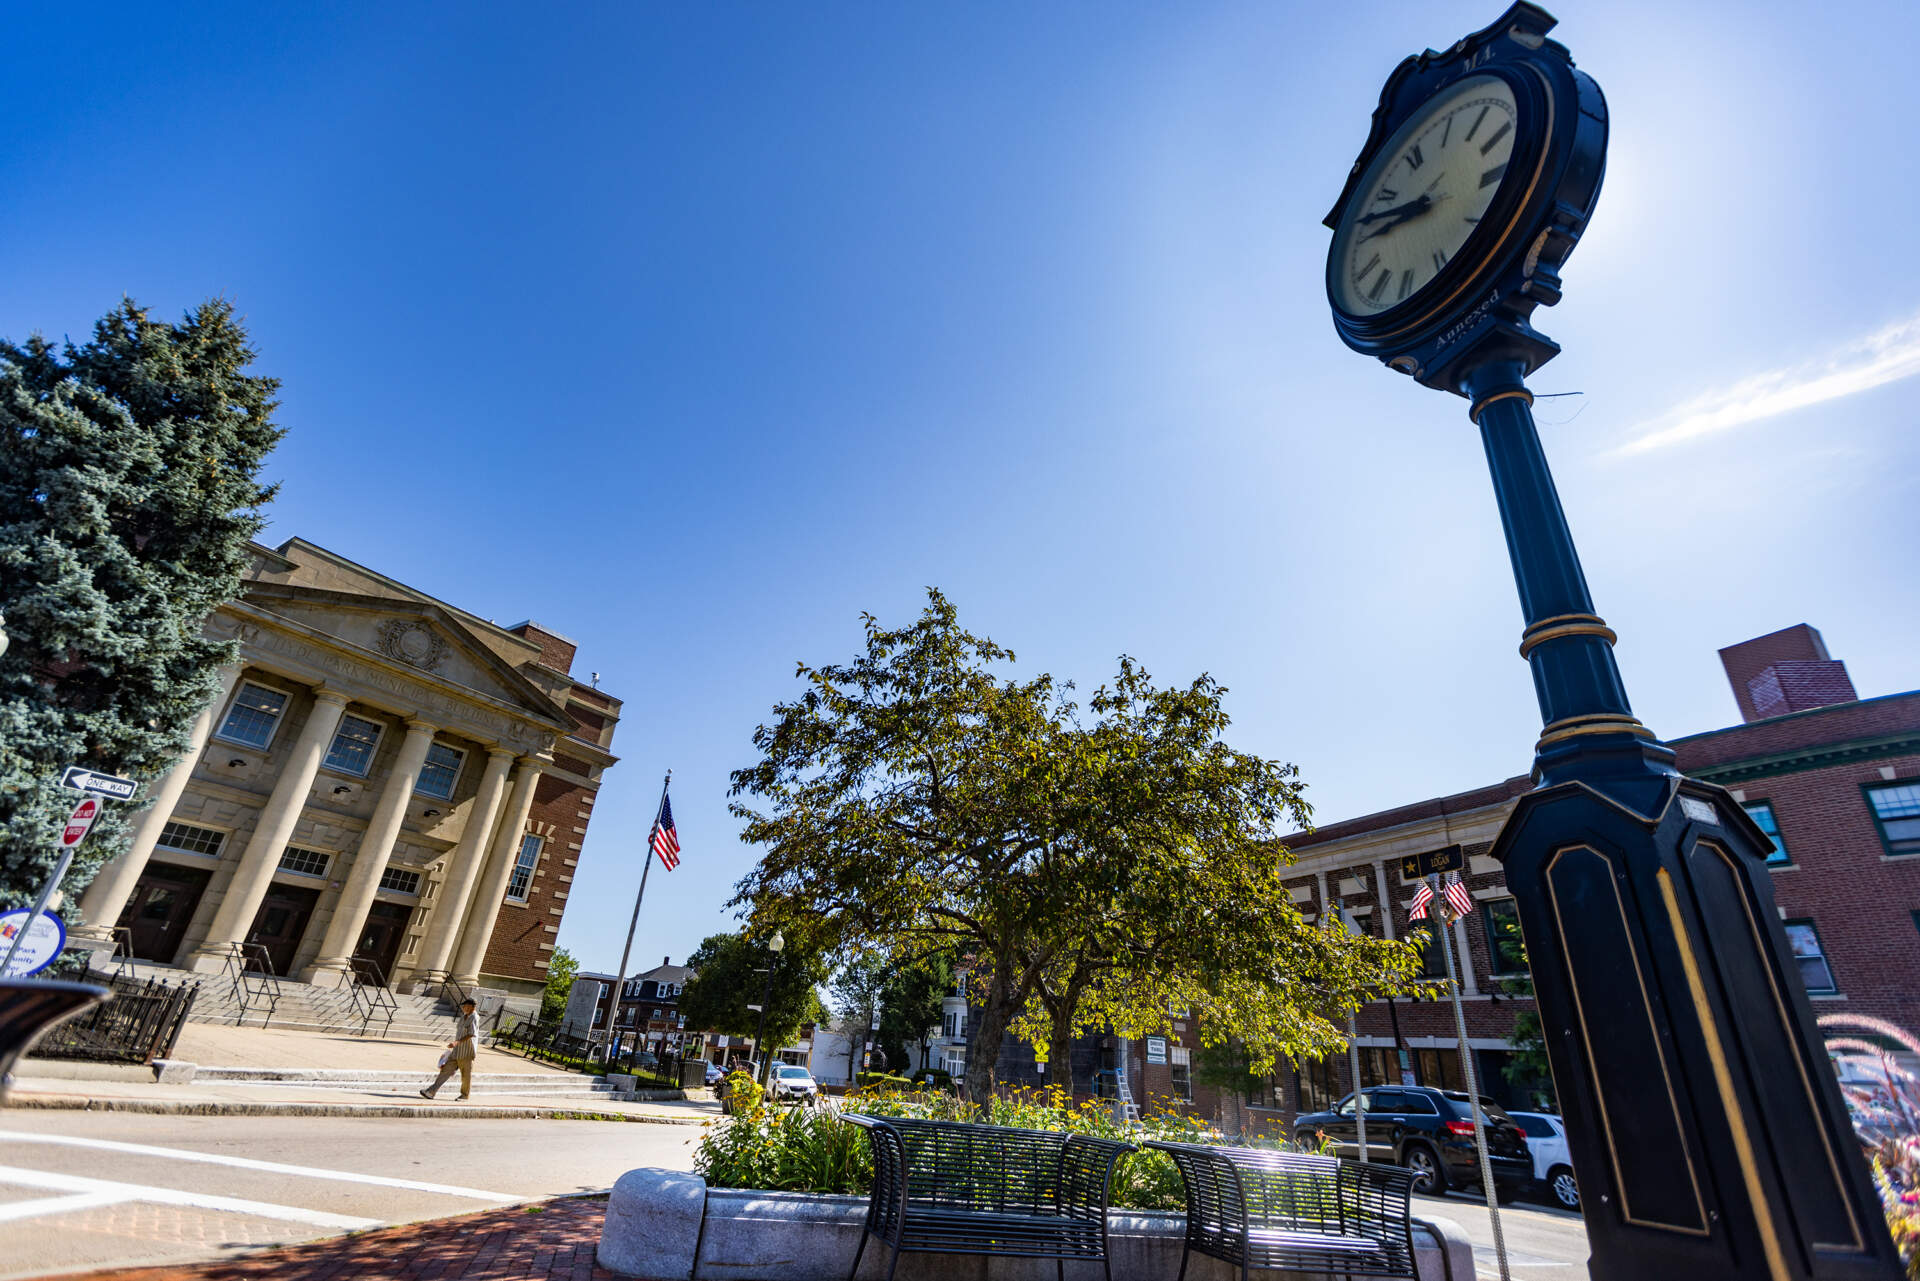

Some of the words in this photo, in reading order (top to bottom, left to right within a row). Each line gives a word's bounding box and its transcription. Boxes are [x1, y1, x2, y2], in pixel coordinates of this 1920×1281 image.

[1435, 288, 1499, 350] Annexed
[322, 654, 360, 680] PARK
[366, 671, 436, 704] MUNICIPAL
[447, 697, 496, 725] BUILDING
[86, 778, 106, 789] ONE
[110, 783, 129, 793] WAY
[67, 827, 83, 835] ENTER
[1431, 855, 1449, 867] LOGAN
[1149, 1040, 1164, 1048] DRIVE
